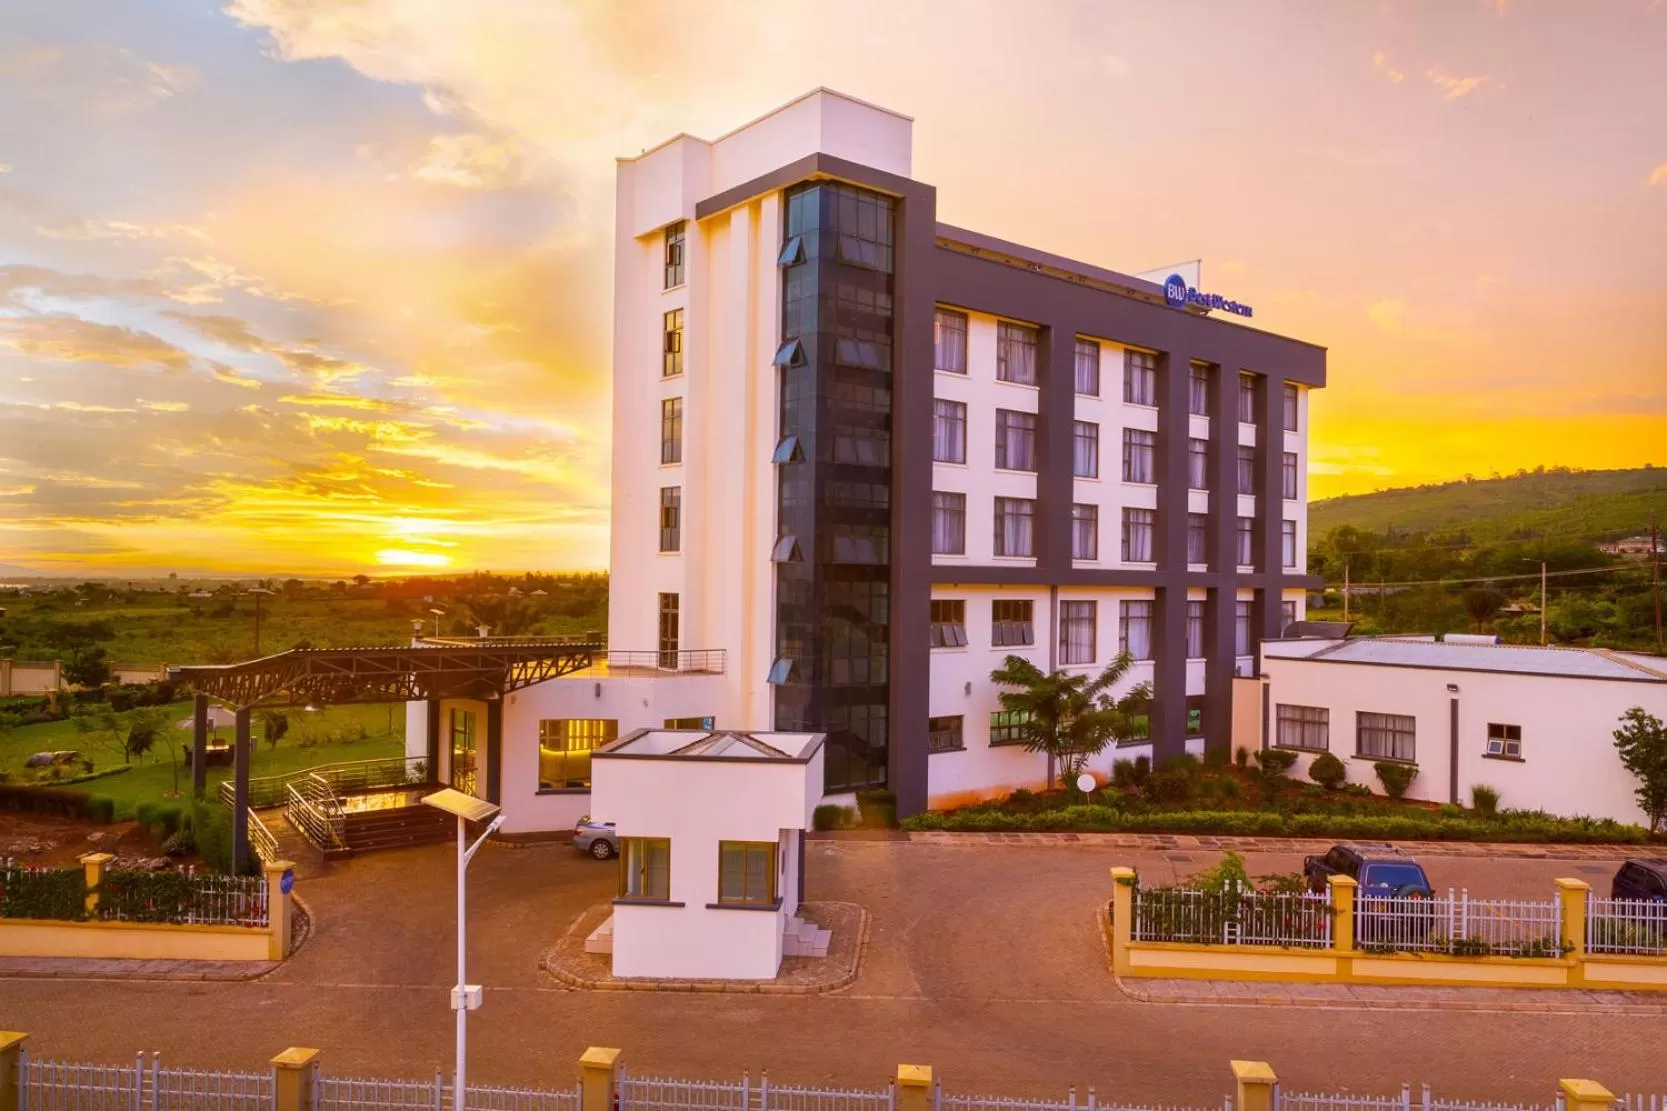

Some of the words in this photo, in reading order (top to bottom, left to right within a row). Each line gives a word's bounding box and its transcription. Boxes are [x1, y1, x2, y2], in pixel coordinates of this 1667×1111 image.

[1167, 283, 1185, 301] BW
[1187, 286, 1210, 306] Best
[1212, 293, 1253, 317] Western
